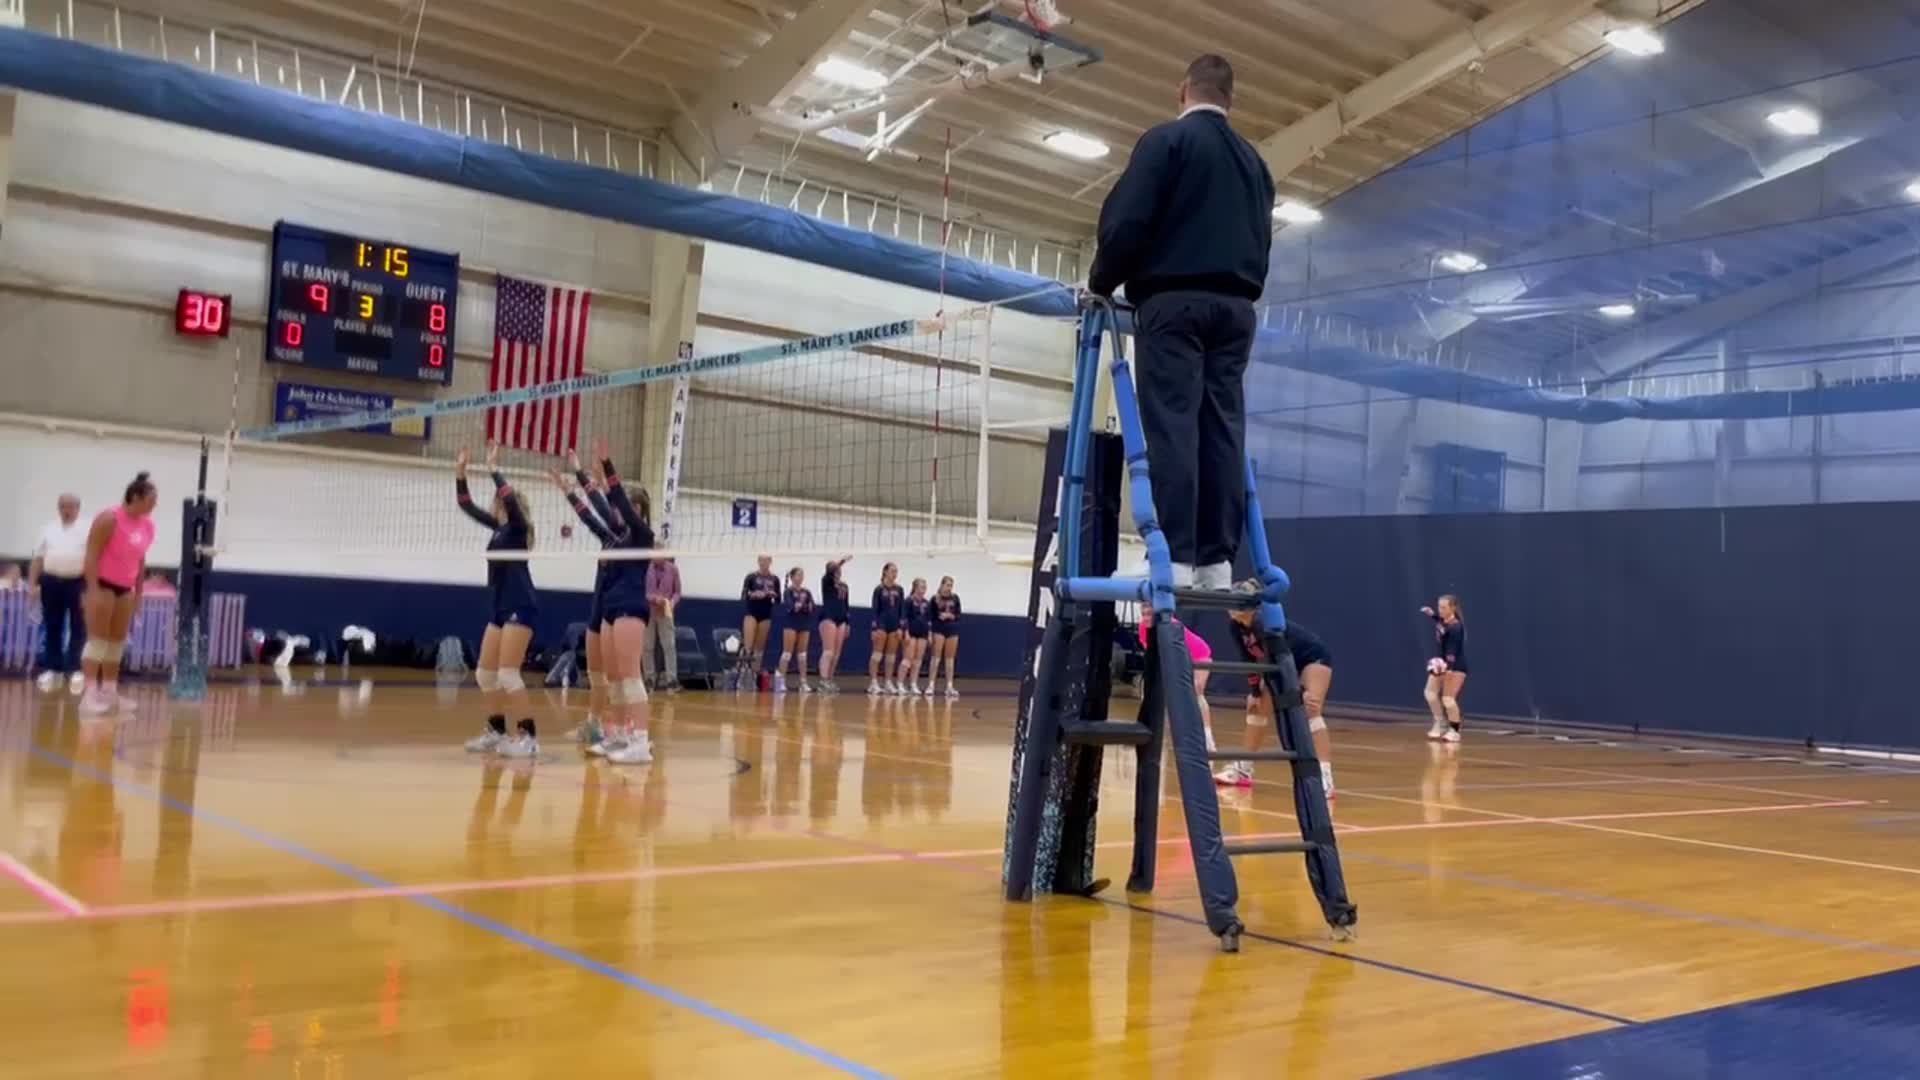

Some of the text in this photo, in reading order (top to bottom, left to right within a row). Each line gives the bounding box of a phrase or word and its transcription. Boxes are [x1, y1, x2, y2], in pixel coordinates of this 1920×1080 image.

[358, 243, 409, 277] 1:15
[282, 261, 350, 284] ST. MARY'S
[310, 284, 328, 312] 9
[405, 283, 446, 301] GUEST
[184, 294, 223, 332] 30
[360, 295, 374, 318] 3
[429, 304, 446, 332] 8
[286, 322, 302, 345] 0
[781, 320, 908, 354] ST. MARY'S LANCERS
[429, 344, 443, 366] 0
[656, 362, 690, 376] MARY'S
[694, 353, 741, 370] LANCERS
[664, 375, 685, 514] ANCERS
[739, 508, 751, 525] 2
